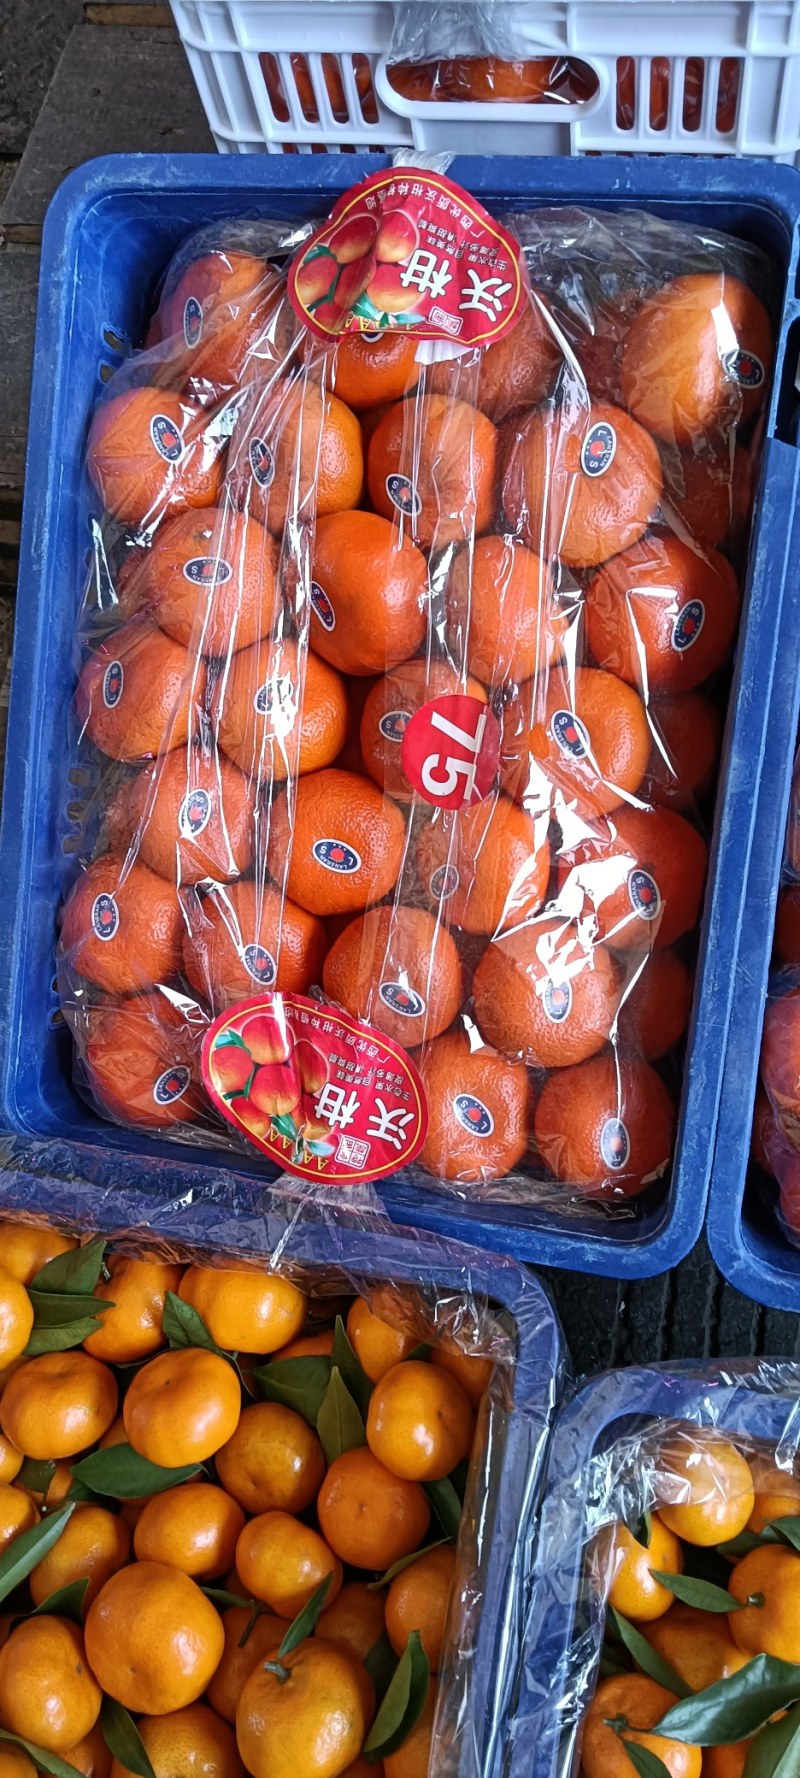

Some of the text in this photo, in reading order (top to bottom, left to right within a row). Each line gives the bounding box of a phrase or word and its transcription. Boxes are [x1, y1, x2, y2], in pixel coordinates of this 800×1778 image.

[400, 250, 512, 321] 沃柑
[156, 420, 178, 457] L S
[588, 427, 607, 469] L S
[390, 479, 399, 489] S
[191, 565, 197, 573] S
[312, 587, 320, 596] S
[677, 606, 699, 644] L S
[558, 715, 583, 752] L S
[421, 711, 487, 801] 75
[318, 845, 353, 865] L S
[319, 854, 347, 869] LANSRAN
[634, 874, 645, 885] S
[262, 971, 271, 979] L
[385, 986, 395, 996] S
[160, 1090, 169, 1099] L
[314, 1081, 416, 1150] 沃柑
[459, 1098, 488, 1130] L S
